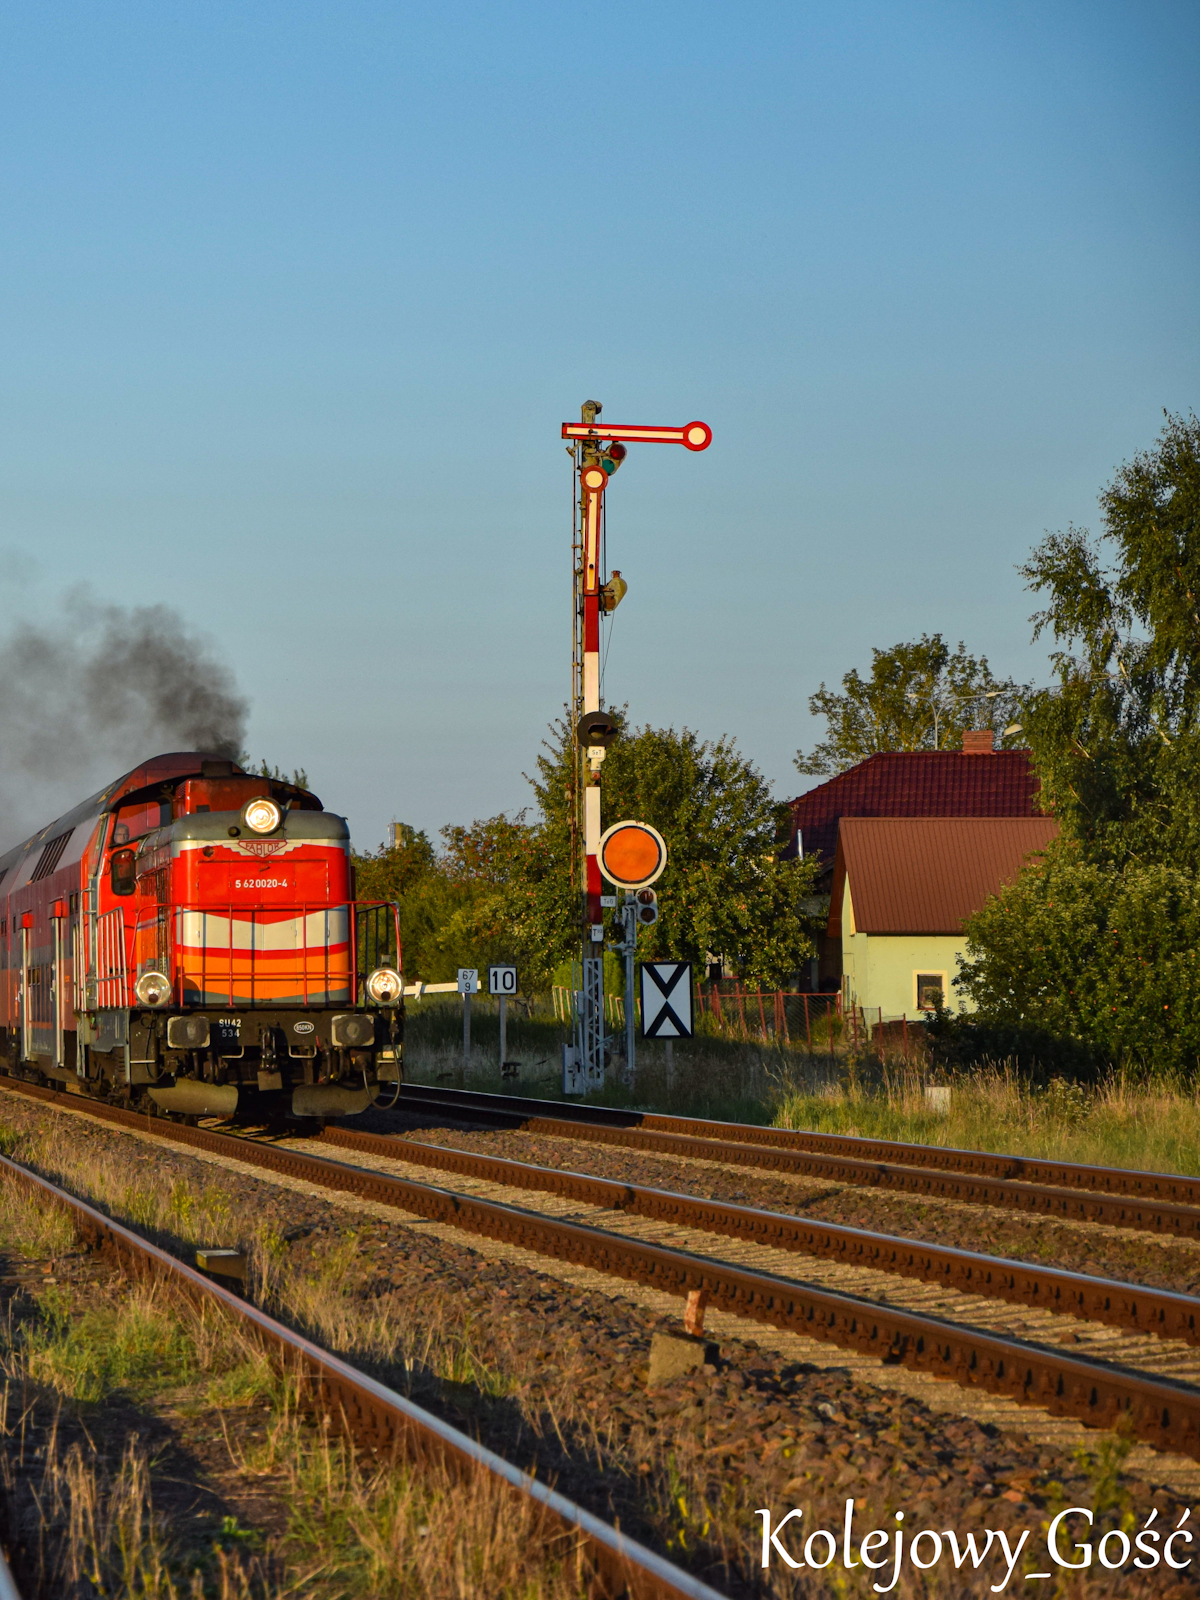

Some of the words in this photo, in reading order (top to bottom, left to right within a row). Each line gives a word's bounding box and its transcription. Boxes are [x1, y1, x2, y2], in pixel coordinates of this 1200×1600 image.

[462, 970, 475, 980] 67
[492, 970, 514, 991] 10
[464, 982, 471, 992] 9
[218, 1018, 242, 1028] SU42
[221, 1028, 240, 1038] 534
